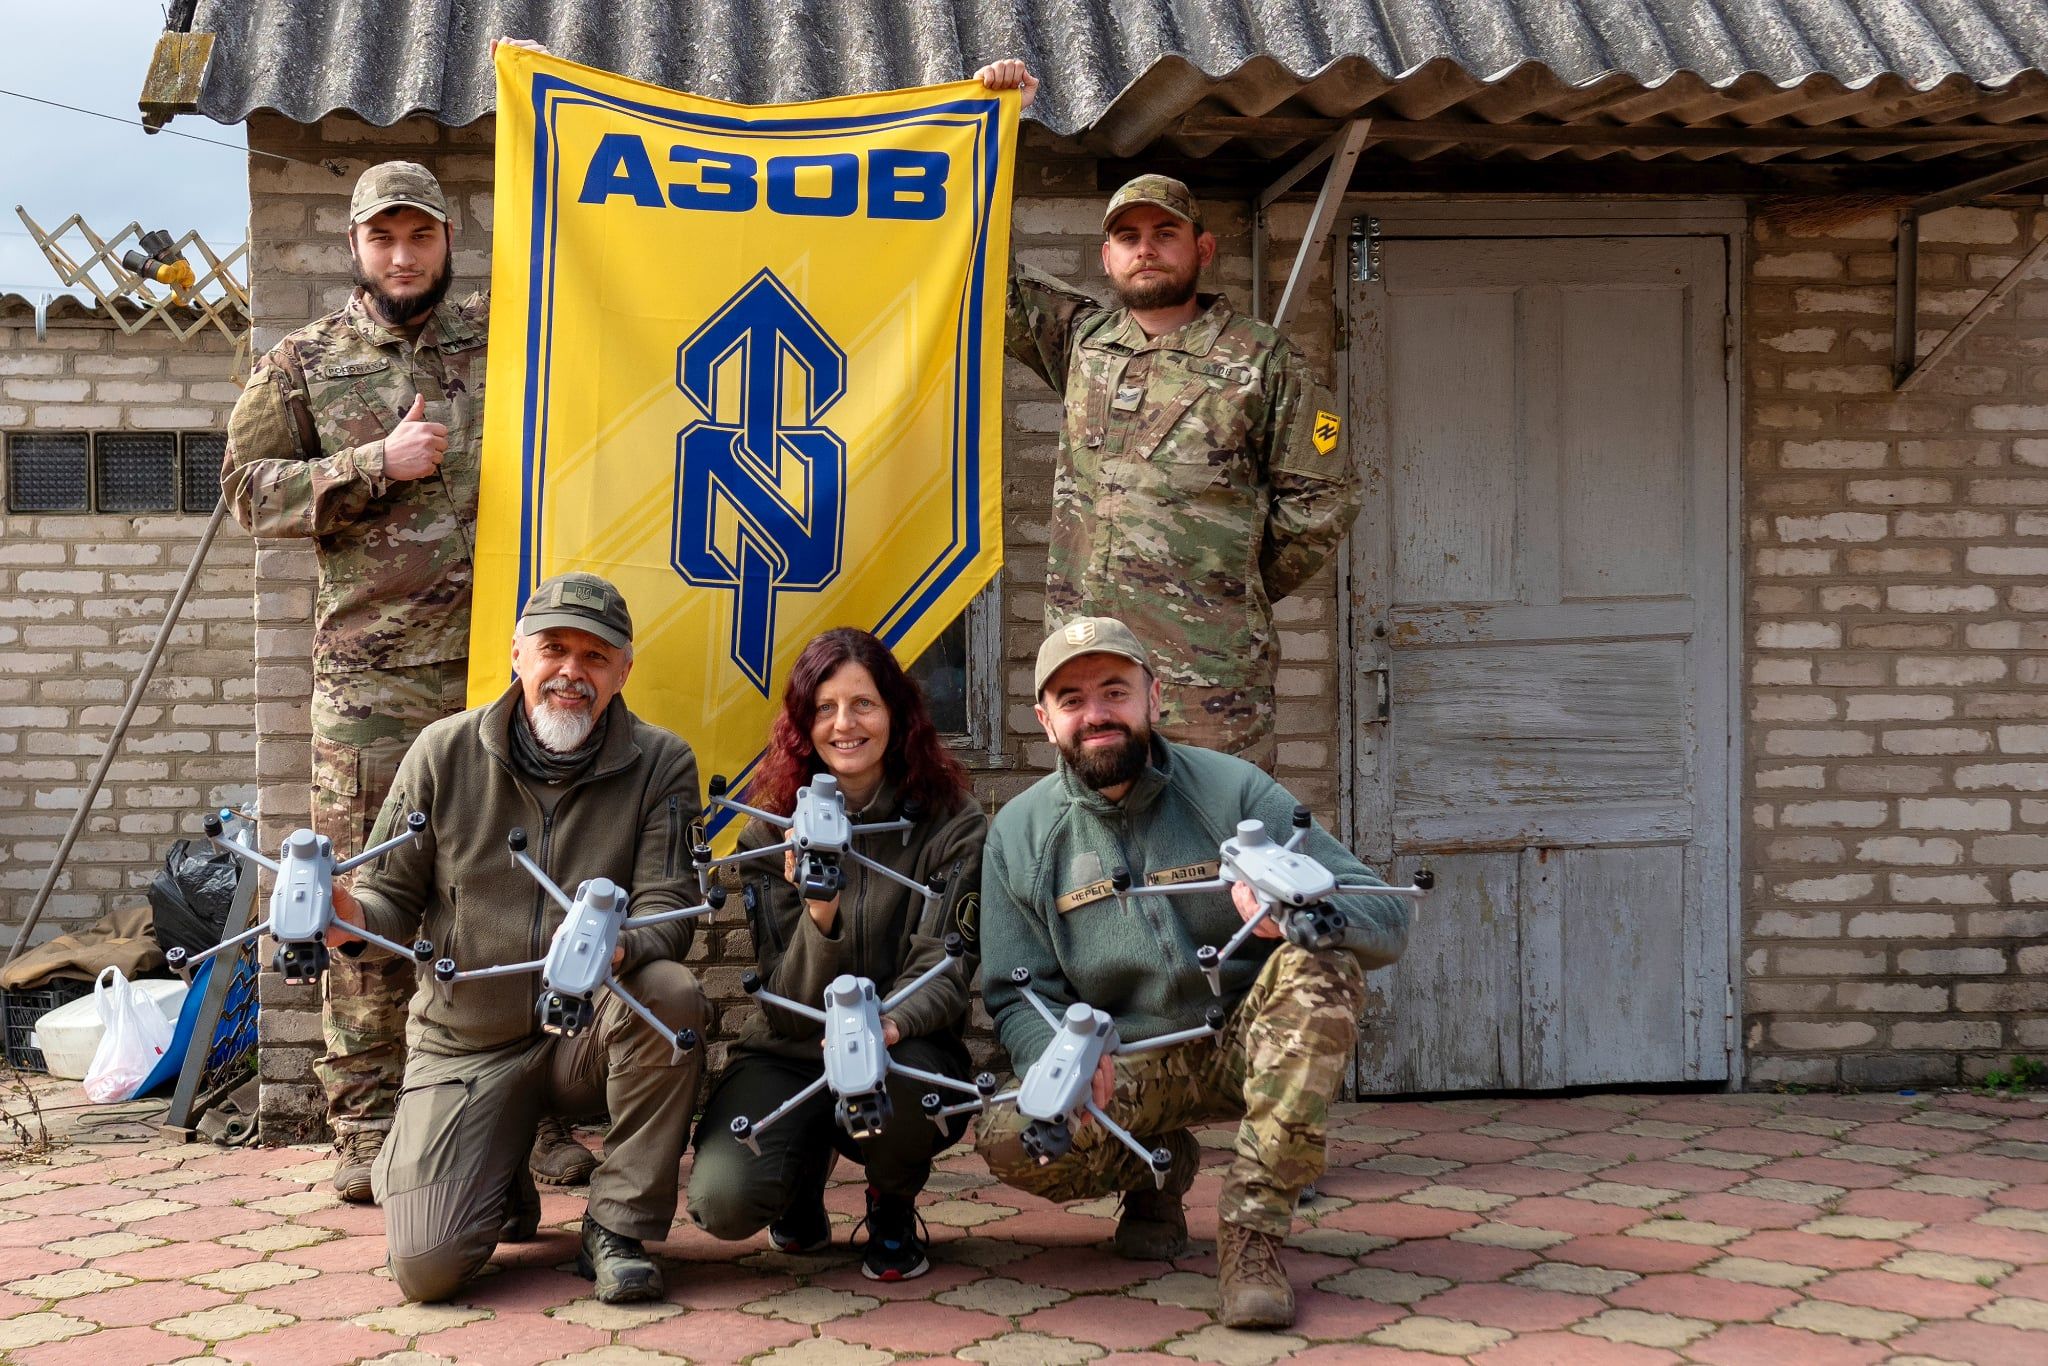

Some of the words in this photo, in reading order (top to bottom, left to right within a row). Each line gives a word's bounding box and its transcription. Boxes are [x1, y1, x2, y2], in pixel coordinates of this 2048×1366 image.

[577, 133, 950, 220] АЗОВ
[1171, 866, 1206, 880] АЗОВ
[1071, 884, 1106, 901] ЧЕРЕП
